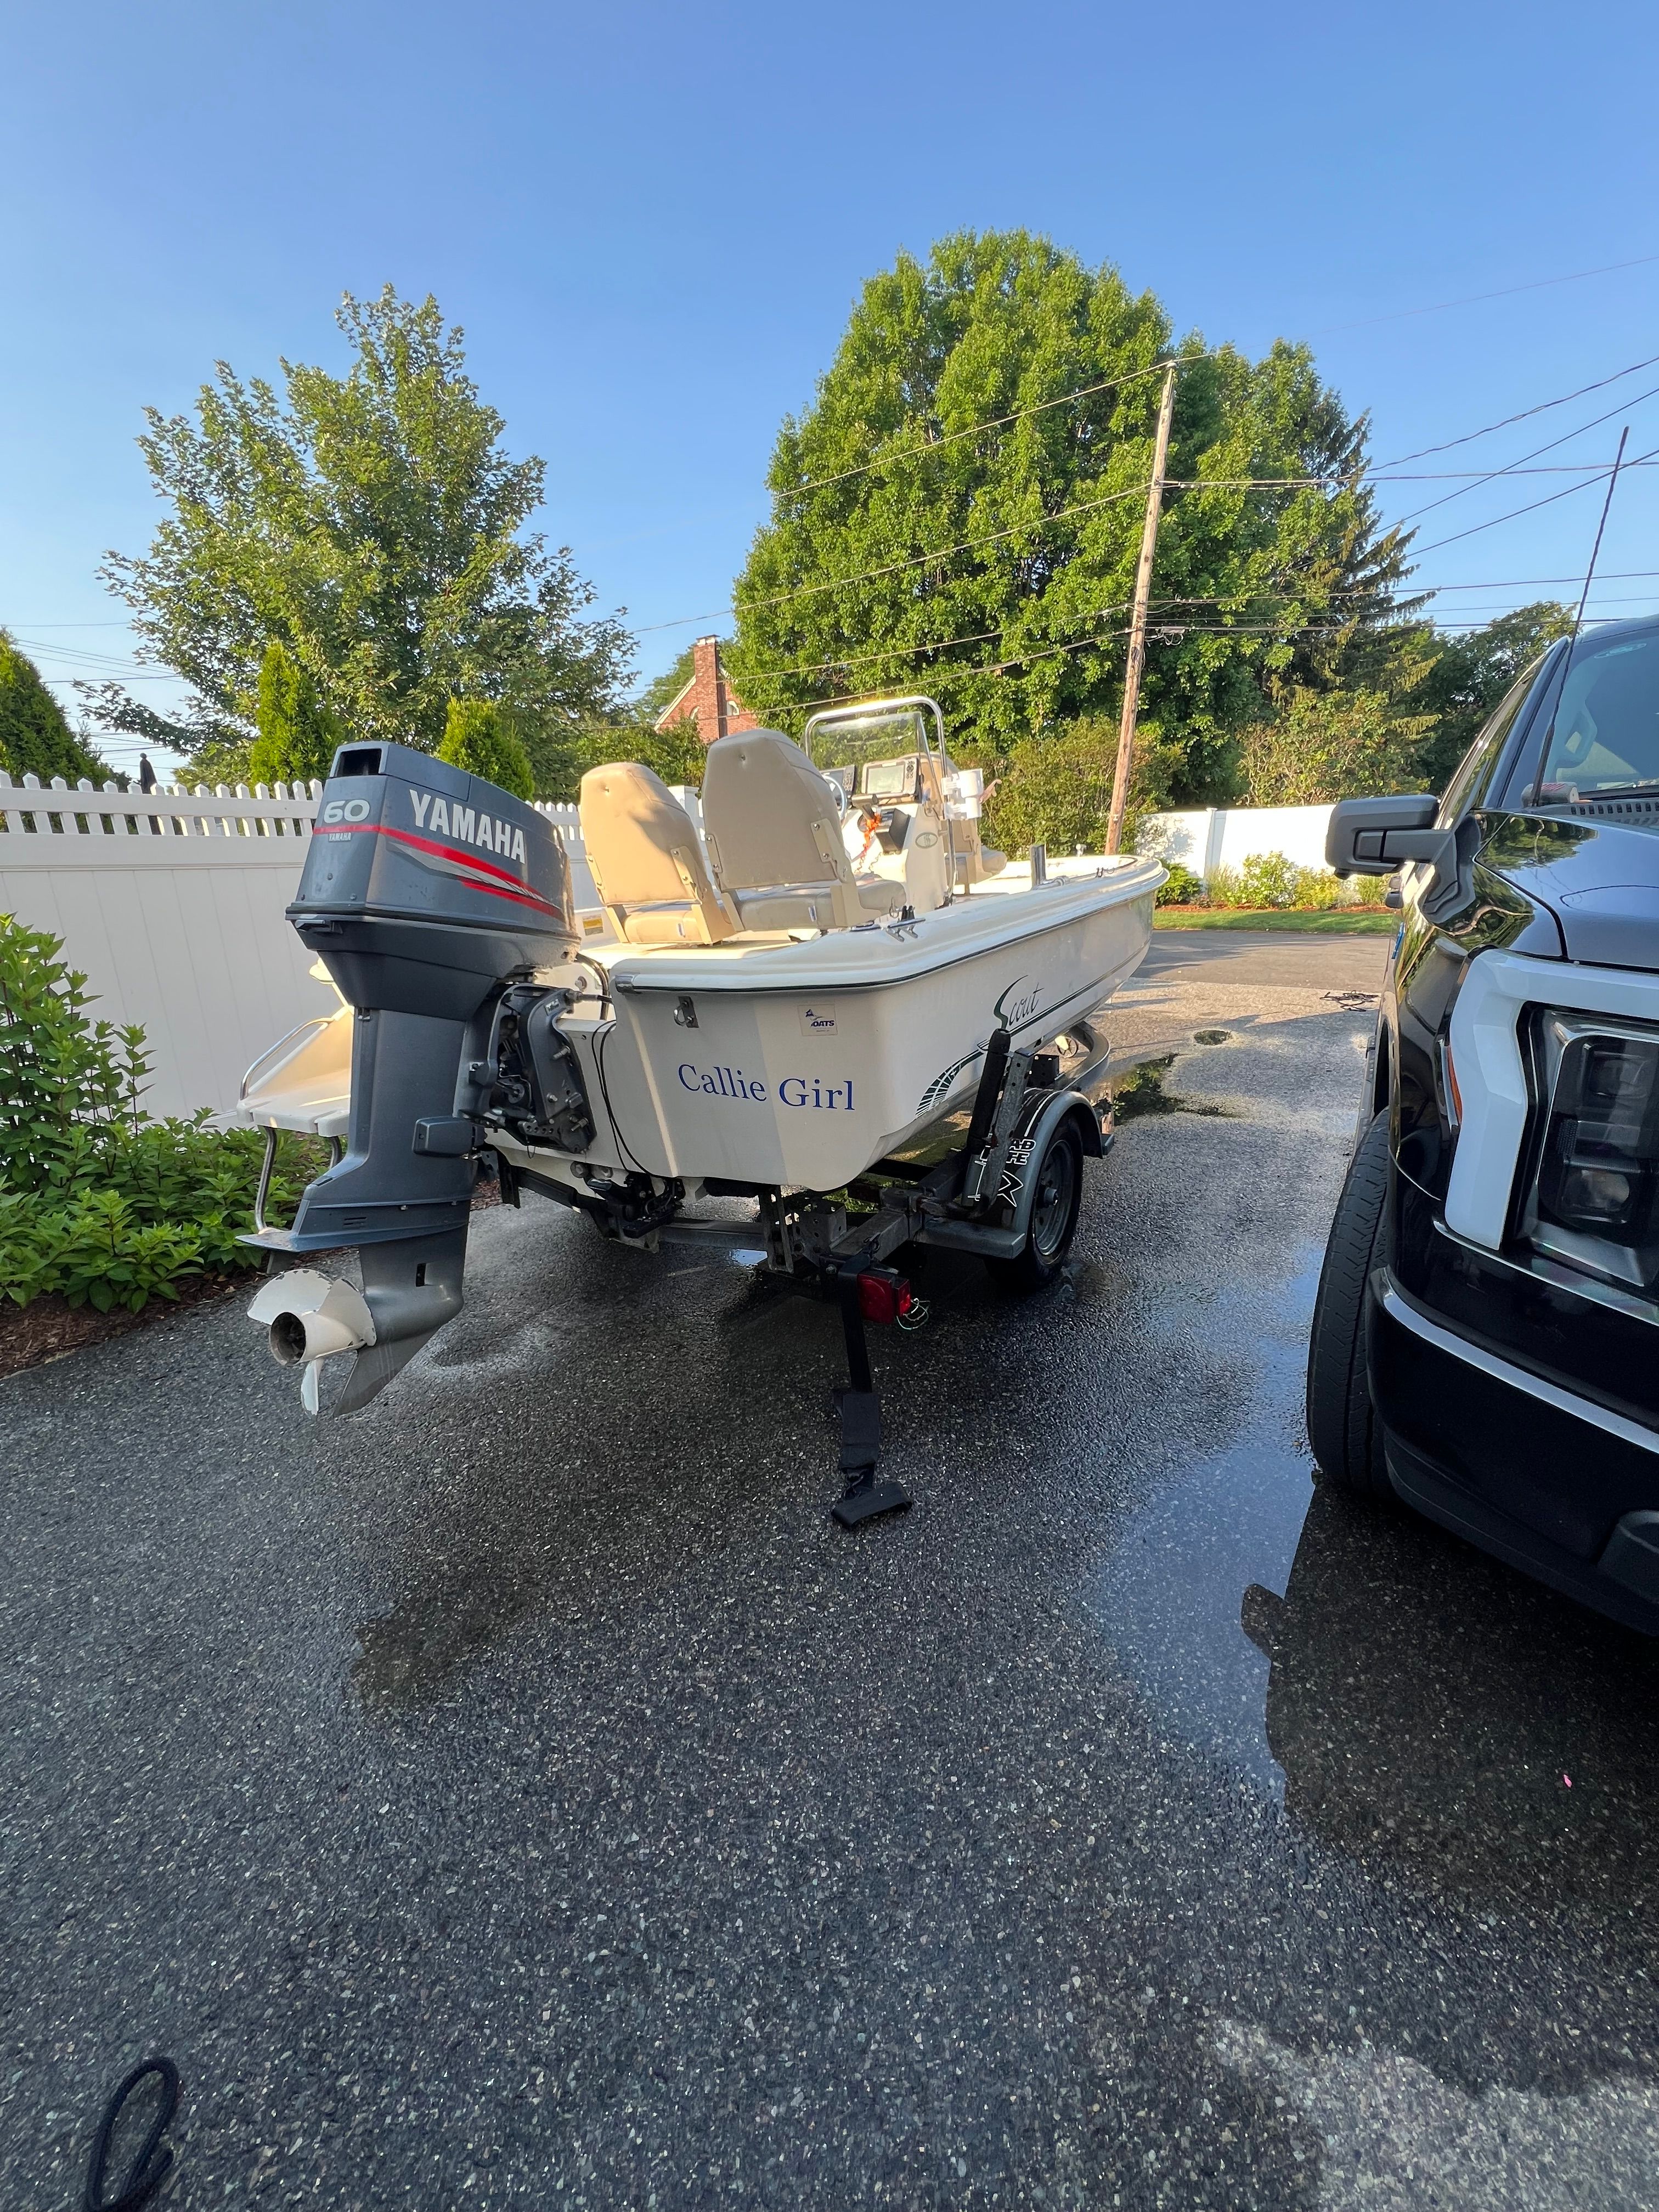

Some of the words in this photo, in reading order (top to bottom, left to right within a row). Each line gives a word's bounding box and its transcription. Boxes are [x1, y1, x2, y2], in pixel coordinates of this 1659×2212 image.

[324, 799, 370, 823] 60
[409, 789, 525, 864] YAMAHA
[329, 832, 351, 842] YAMAHA
[994, 975, 1045, 1030] Scout
[678, 1064, 767, 1102] Callie
[779, 1078, 855, 1110] Girl
